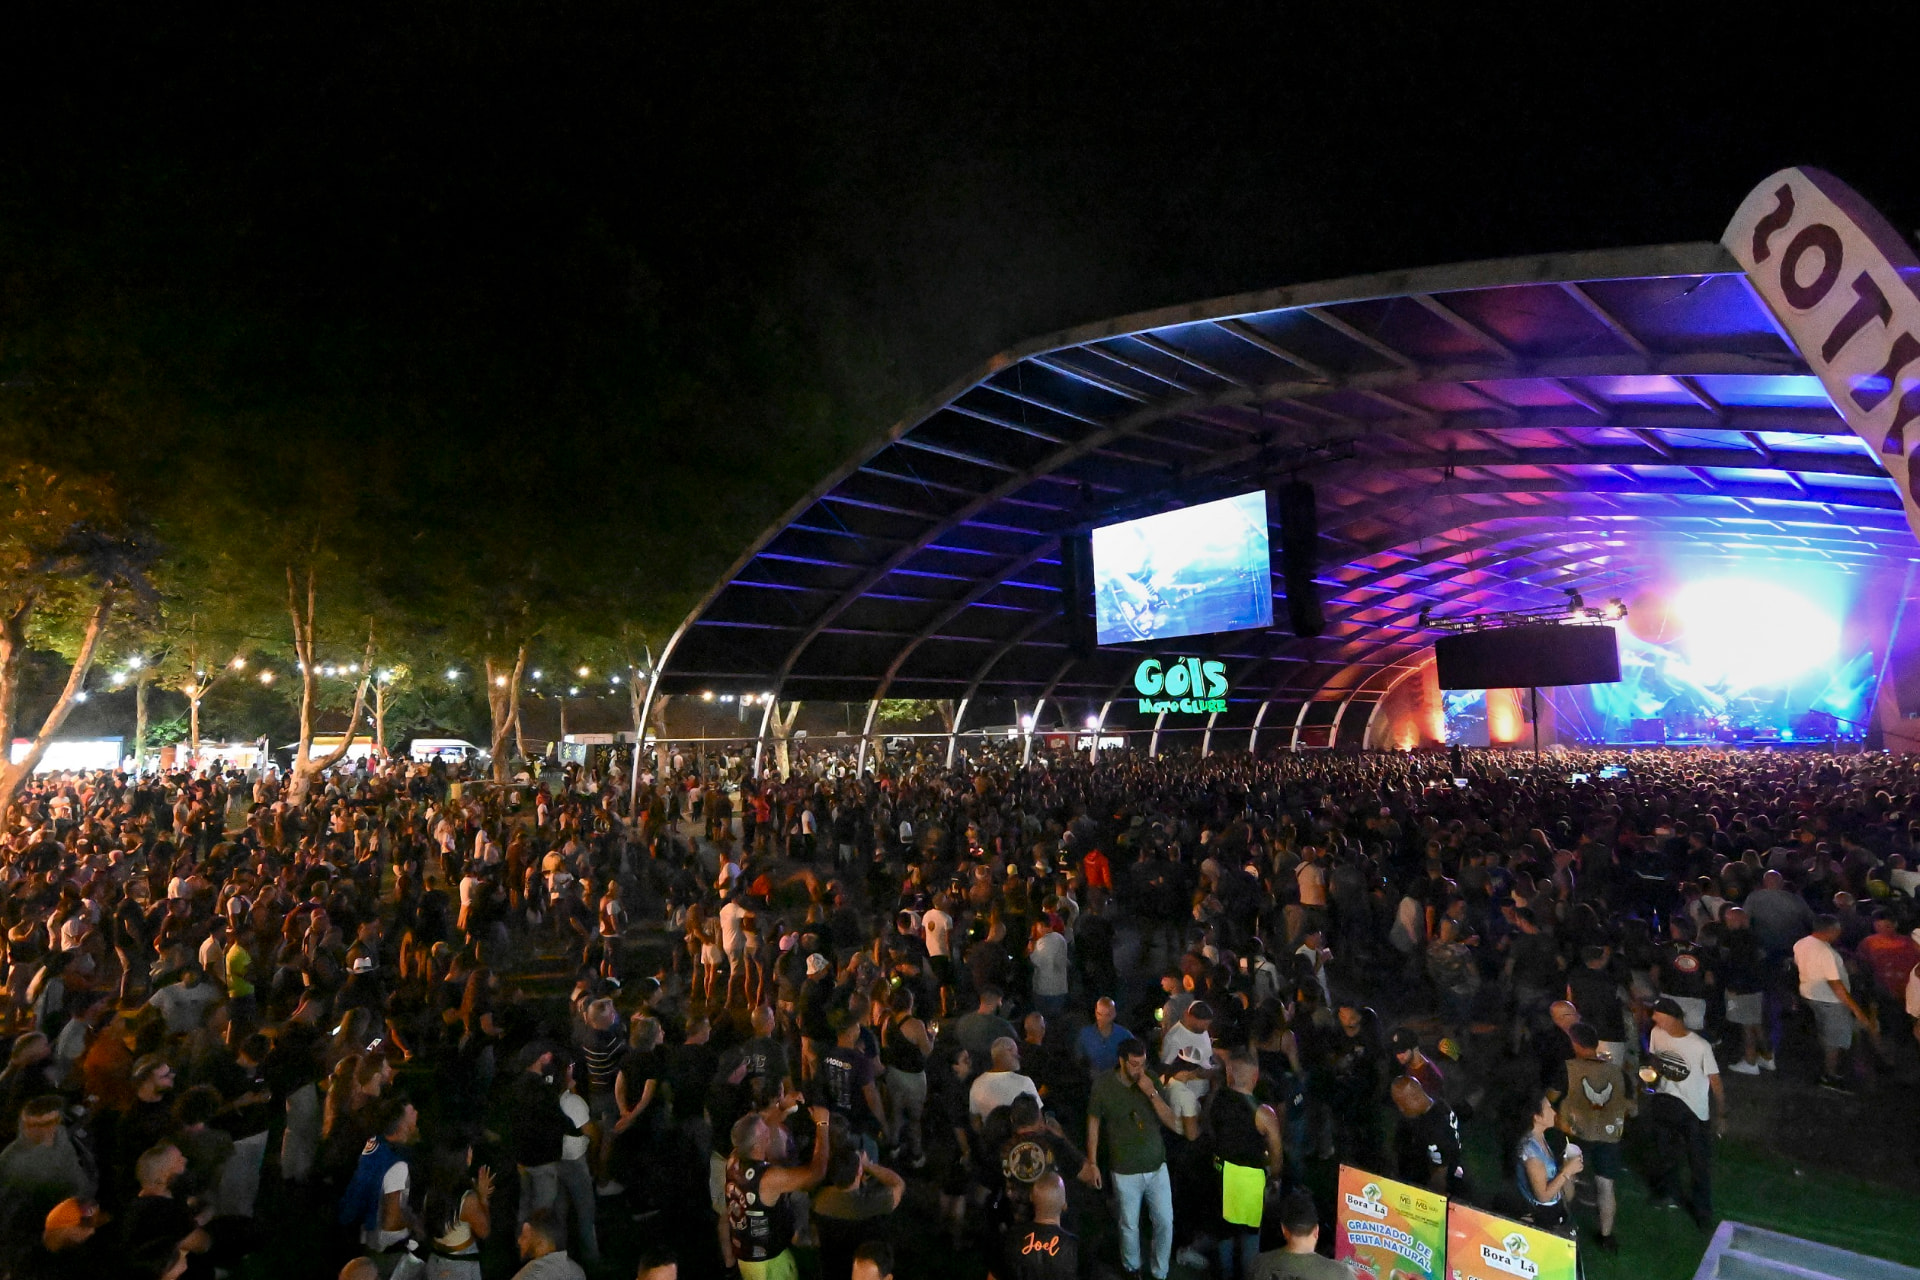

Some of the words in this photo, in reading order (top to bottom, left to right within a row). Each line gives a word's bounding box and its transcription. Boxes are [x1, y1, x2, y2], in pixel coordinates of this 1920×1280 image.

[1347, 1195, 1368, 1209] Bora
[1374, 1204, 1386, 1215] Lá
[1021, 1231, 1060, 1256] Joel
[1348, 1221, 1412, 1245] GRANIZADOS
[1416, 1242, 1432, 1258] DE
[1349, 1234, 1381, 1247] FRUTA
[1383, 1239, 1432, 1271] NATURAL
[1482, 1246, 1511, 1265] Bora
[1520, 1260, 1535, 1273] Lá
